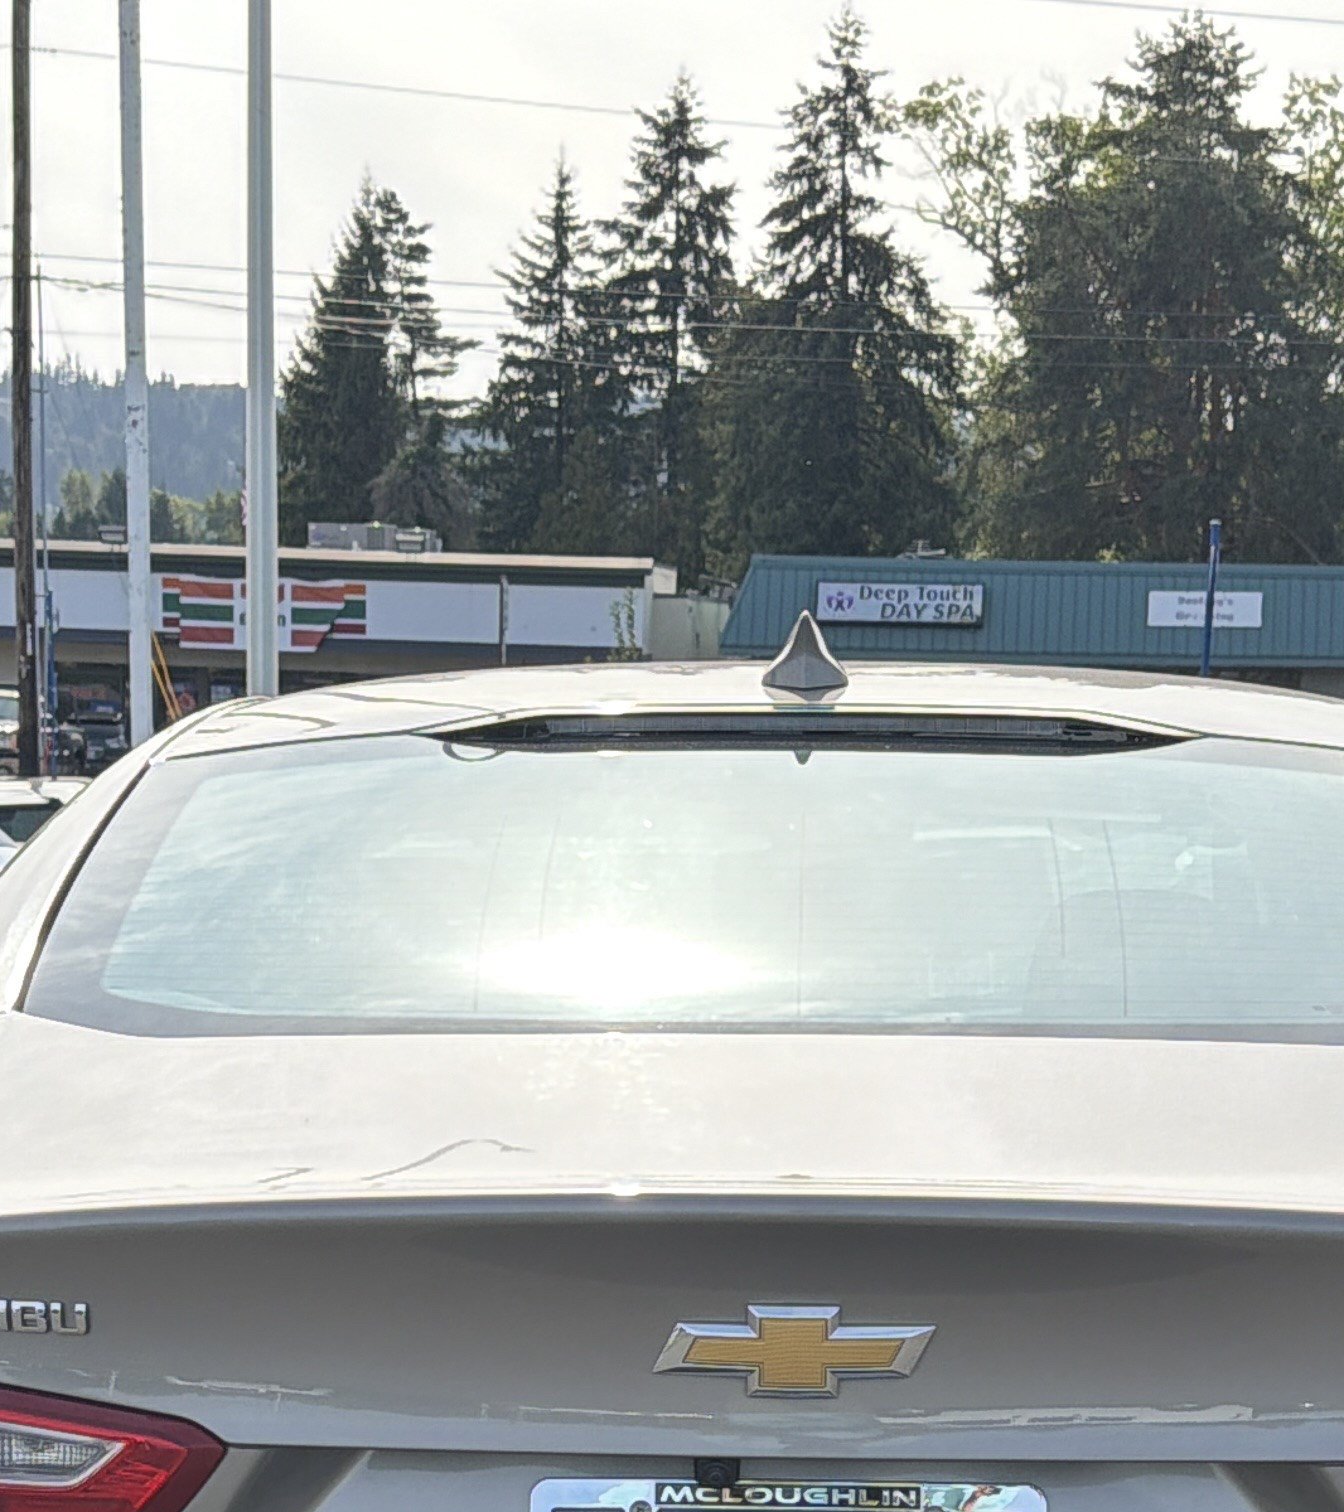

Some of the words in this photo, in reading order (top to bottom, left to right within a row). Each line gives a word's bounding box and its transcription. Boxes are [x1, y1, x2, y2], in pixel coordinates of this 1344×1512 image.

[859, 585, 909, 603] Deep
[918, 586, 974, 602] Touch
[880, 602, 929, 619] DAY
[932, 602, 975, 620] SPA
[660, 1485, 917, 1507] MCLOUGHLIN
